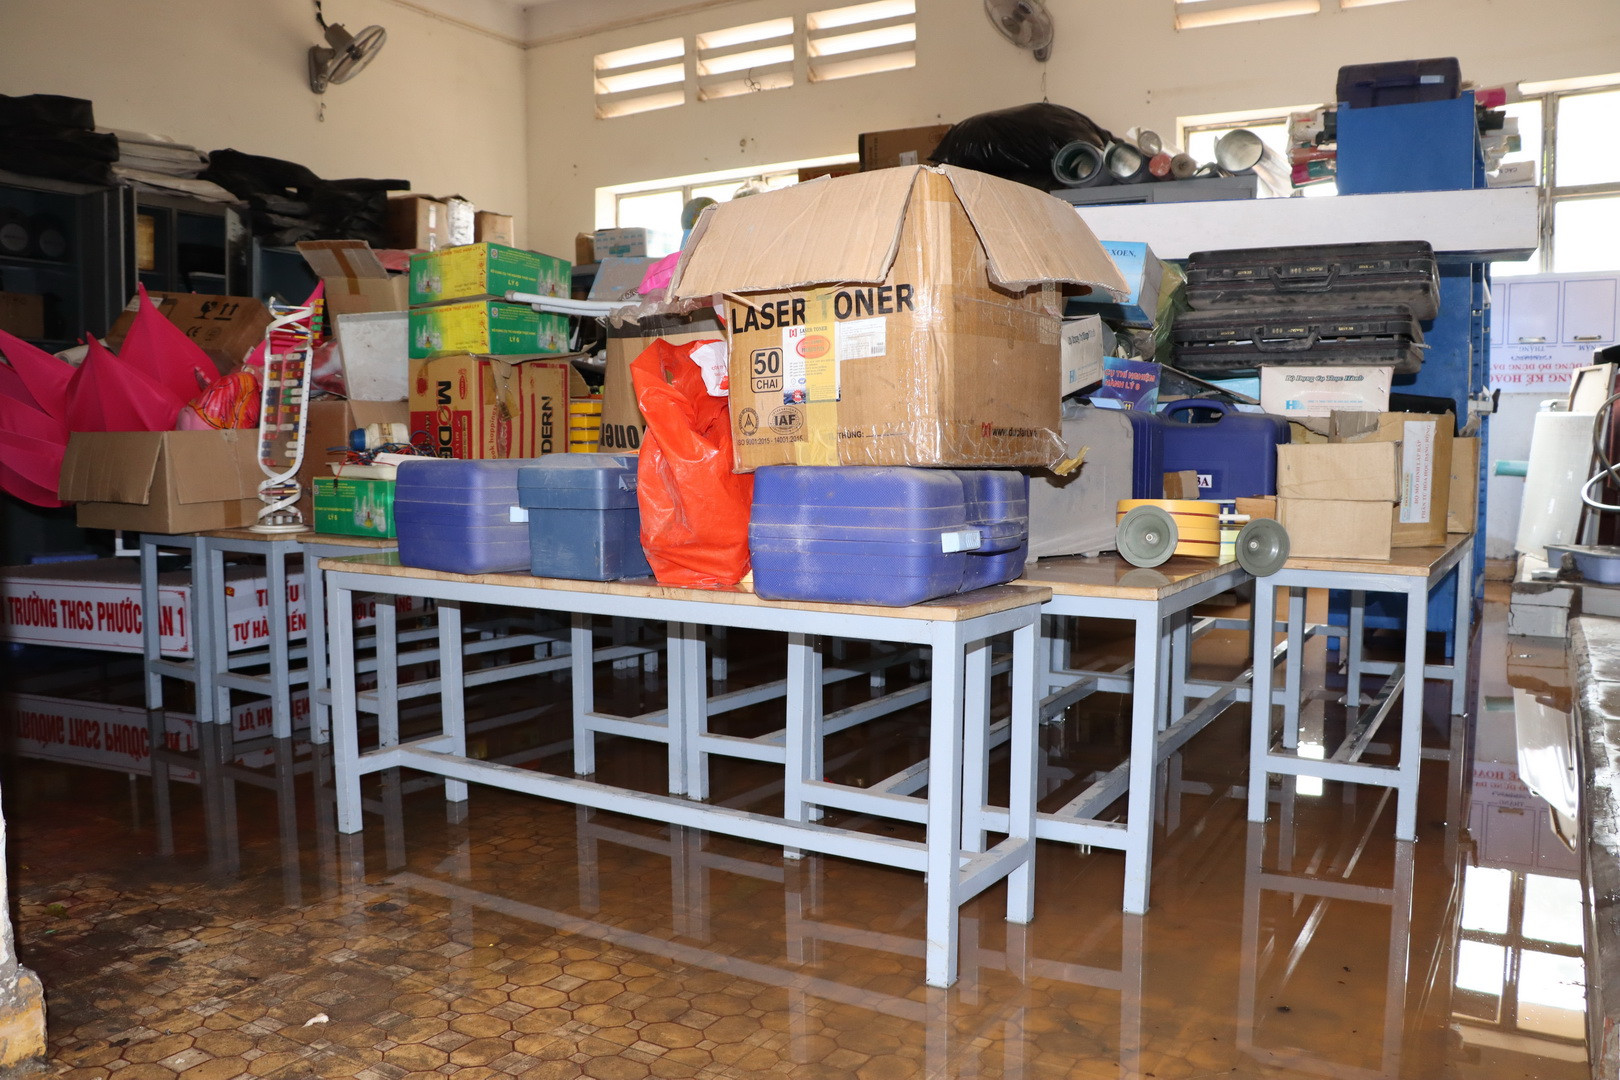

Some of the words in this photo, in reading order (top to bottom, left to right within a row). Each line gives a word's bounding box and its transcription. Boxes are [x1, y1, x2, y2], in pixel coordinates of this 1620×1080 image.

[731, 297, 806, 335] LASER
[816, 284, 915, 321] TONER
[753, 350, 780, 375] 50
[756, 379, 778, 390] CHAI
[541, 396, 553, 456] DERN
[774, 414, 796, 426] IAF
[8, 591, 57, 628] TRƯỜNG
[60, 599, 94, 631] THCS
[97, 596, 143, 635] PHƯỚC
[233, 619, 250, 645] TỰ
[253, 615, 270, 639] HÀ
[287, 608, 307, 633] IẾN
